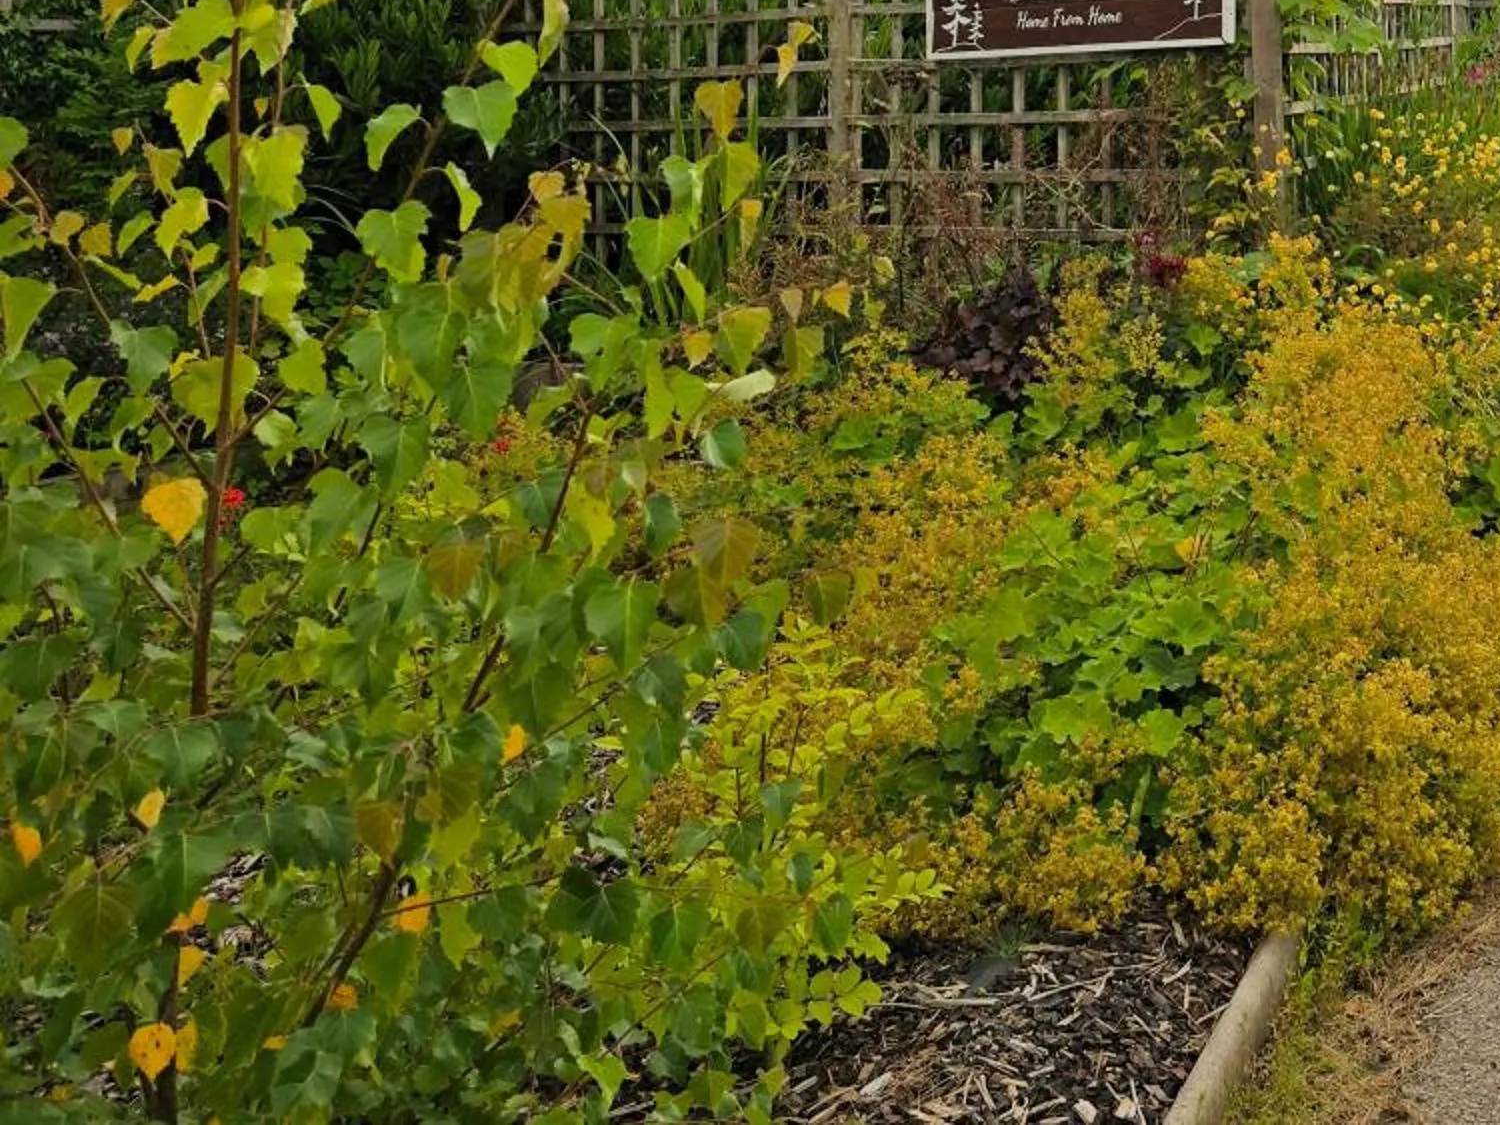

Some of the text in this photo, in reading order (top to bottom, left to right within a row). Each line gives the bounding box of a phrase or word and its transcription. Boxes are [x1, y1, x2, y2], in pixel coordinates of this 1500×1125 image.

[1016, 4, 1123, 29] Home From Home
